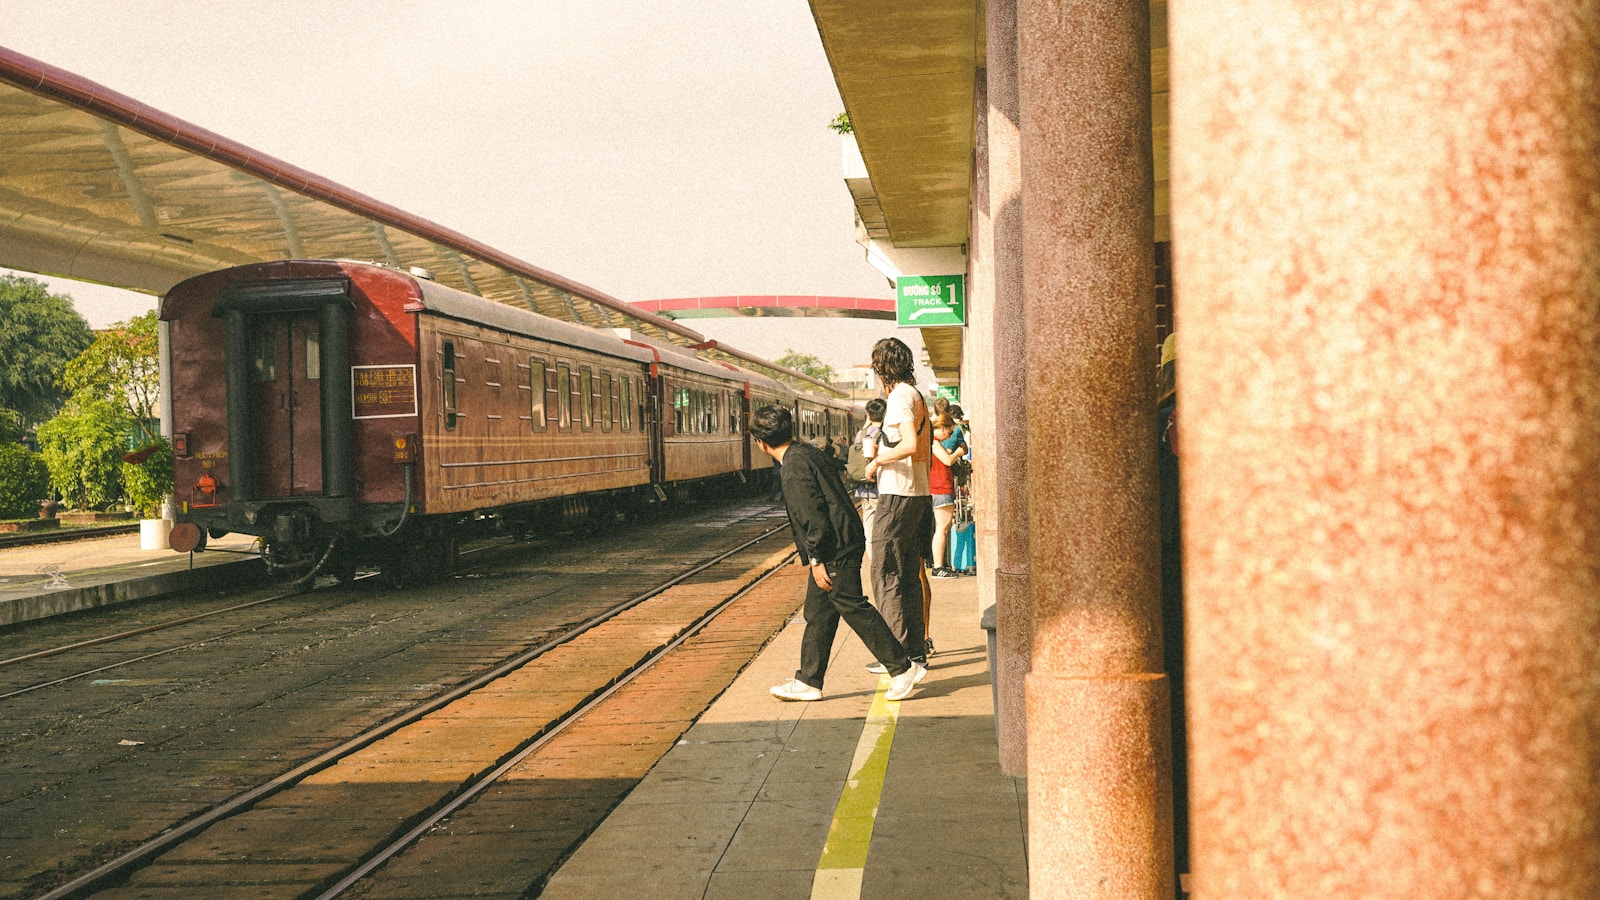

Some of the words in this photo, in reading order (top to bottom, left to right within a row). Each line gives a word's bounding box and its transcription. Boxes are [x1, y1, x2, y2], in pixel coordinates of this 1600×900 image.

[930, 281, 942, 296] SỐ
[946, 283, 960, 305] 1
[913, 298, 942, 306] TRACK
